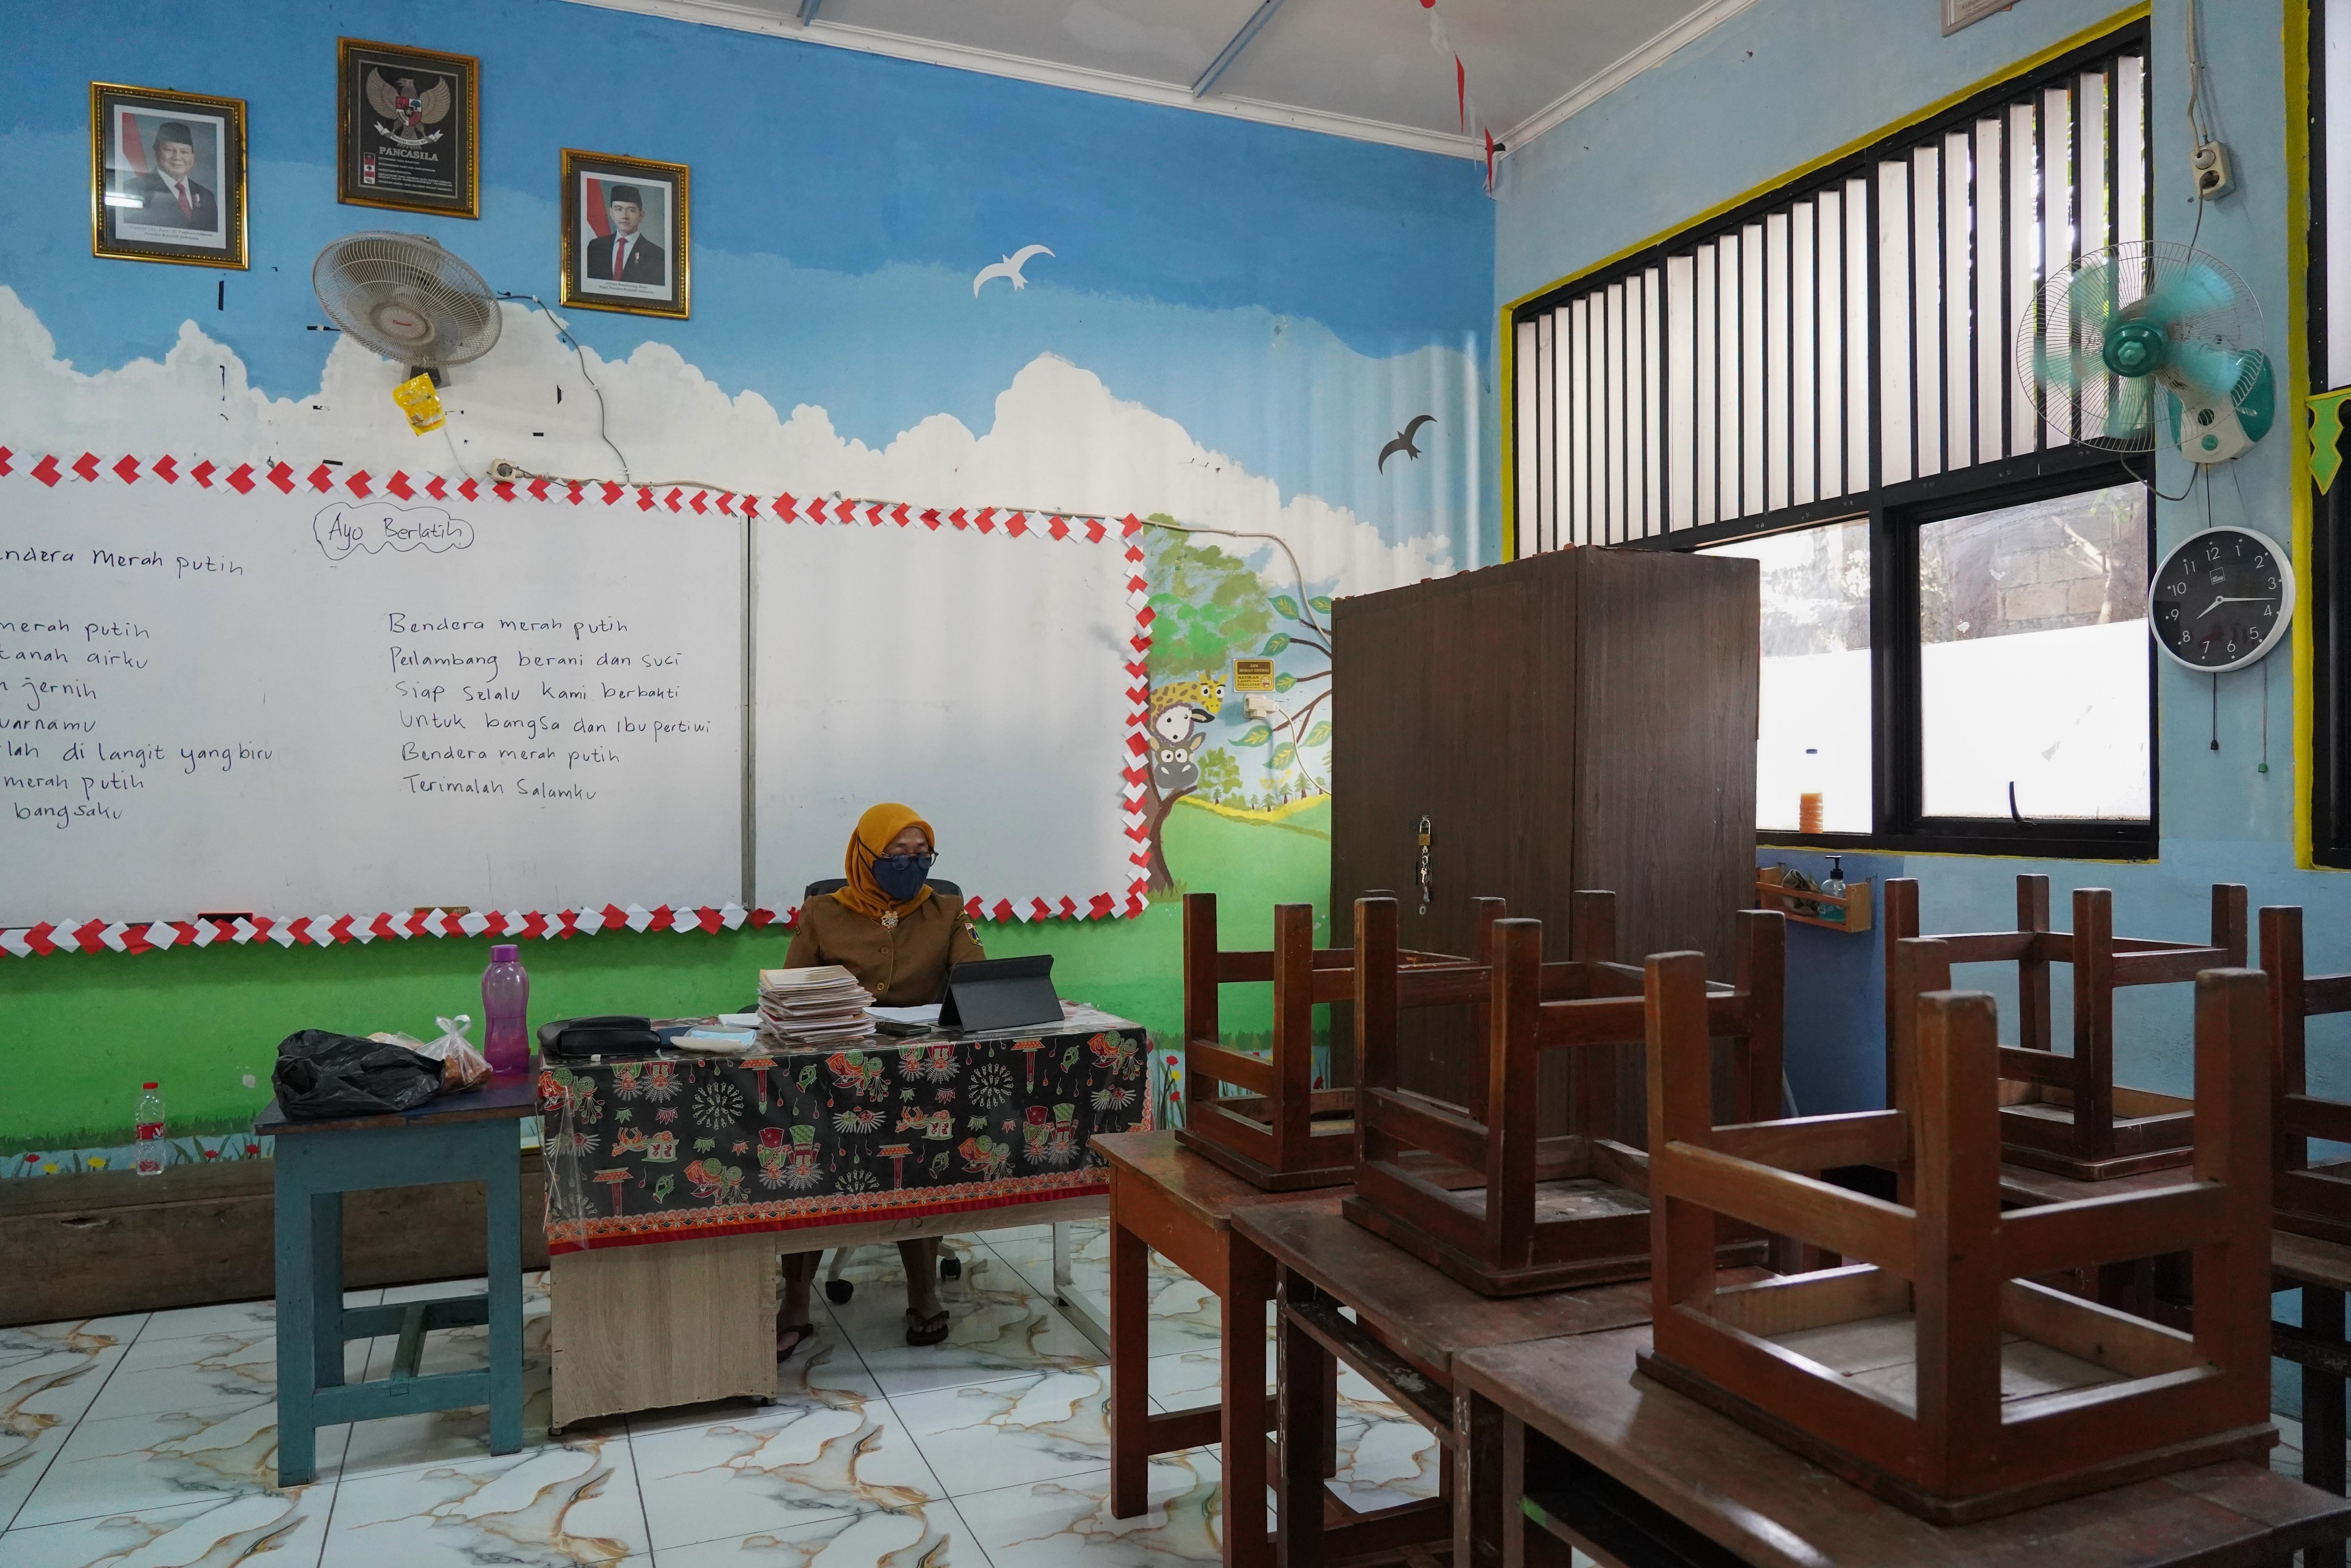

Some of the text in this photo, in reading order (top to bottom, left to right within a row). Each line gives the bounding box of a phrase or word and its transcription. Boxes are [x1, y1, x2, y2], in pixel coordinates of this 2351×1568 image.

[379, 146, 439, 161] PANCASILA
[329, 512, 461, 550] Ayo Berlatih
[2206, 547, 2220, 561] 12
[2235, 545, 2240, 556] 1
[0, 546, 74, 563] ndera
[176, 555, 243, 579] putih
[2184, 561, 2195, 575] 11
[2254, 555, 2264, 568] 2
[2171, 582, 2186, 596] 10
[2268, 577, 2277, 590] 3
[2171, 609, 2179, 621] 9
[2263, 604, 2273, 616] 4
[85, 621, 149, 642] putih
[389, 612, 628, 641] Bendera merah putih
[2250, 627, 2258, 639] 5
[2182, 630, 2190, 642] 8
[2202, 641, 2210, 653] 7
[2227, 640, 2235, 652] 6
[87, 650, 148, 669] airku
[390, 646, 499, 683] Perlambang
[518, 650, 583, 667] berani
[596, 652, 630, 666] dan
[21, 677, 97, 711] jernih
[396, 681, 445, 703] Siap
[400, 710, 466, 729] Untuk
[574, 717, 606, 733] dan
[0, 740, 39, 758] lah
[63, 742, 85, 761] di
[98, 742, 165, 768] langit
[402, 741, 620, 770] Bendera merah putih
[4, 770, 144, 800] merah putih
[402, 774, 504, 794] Terimalah
